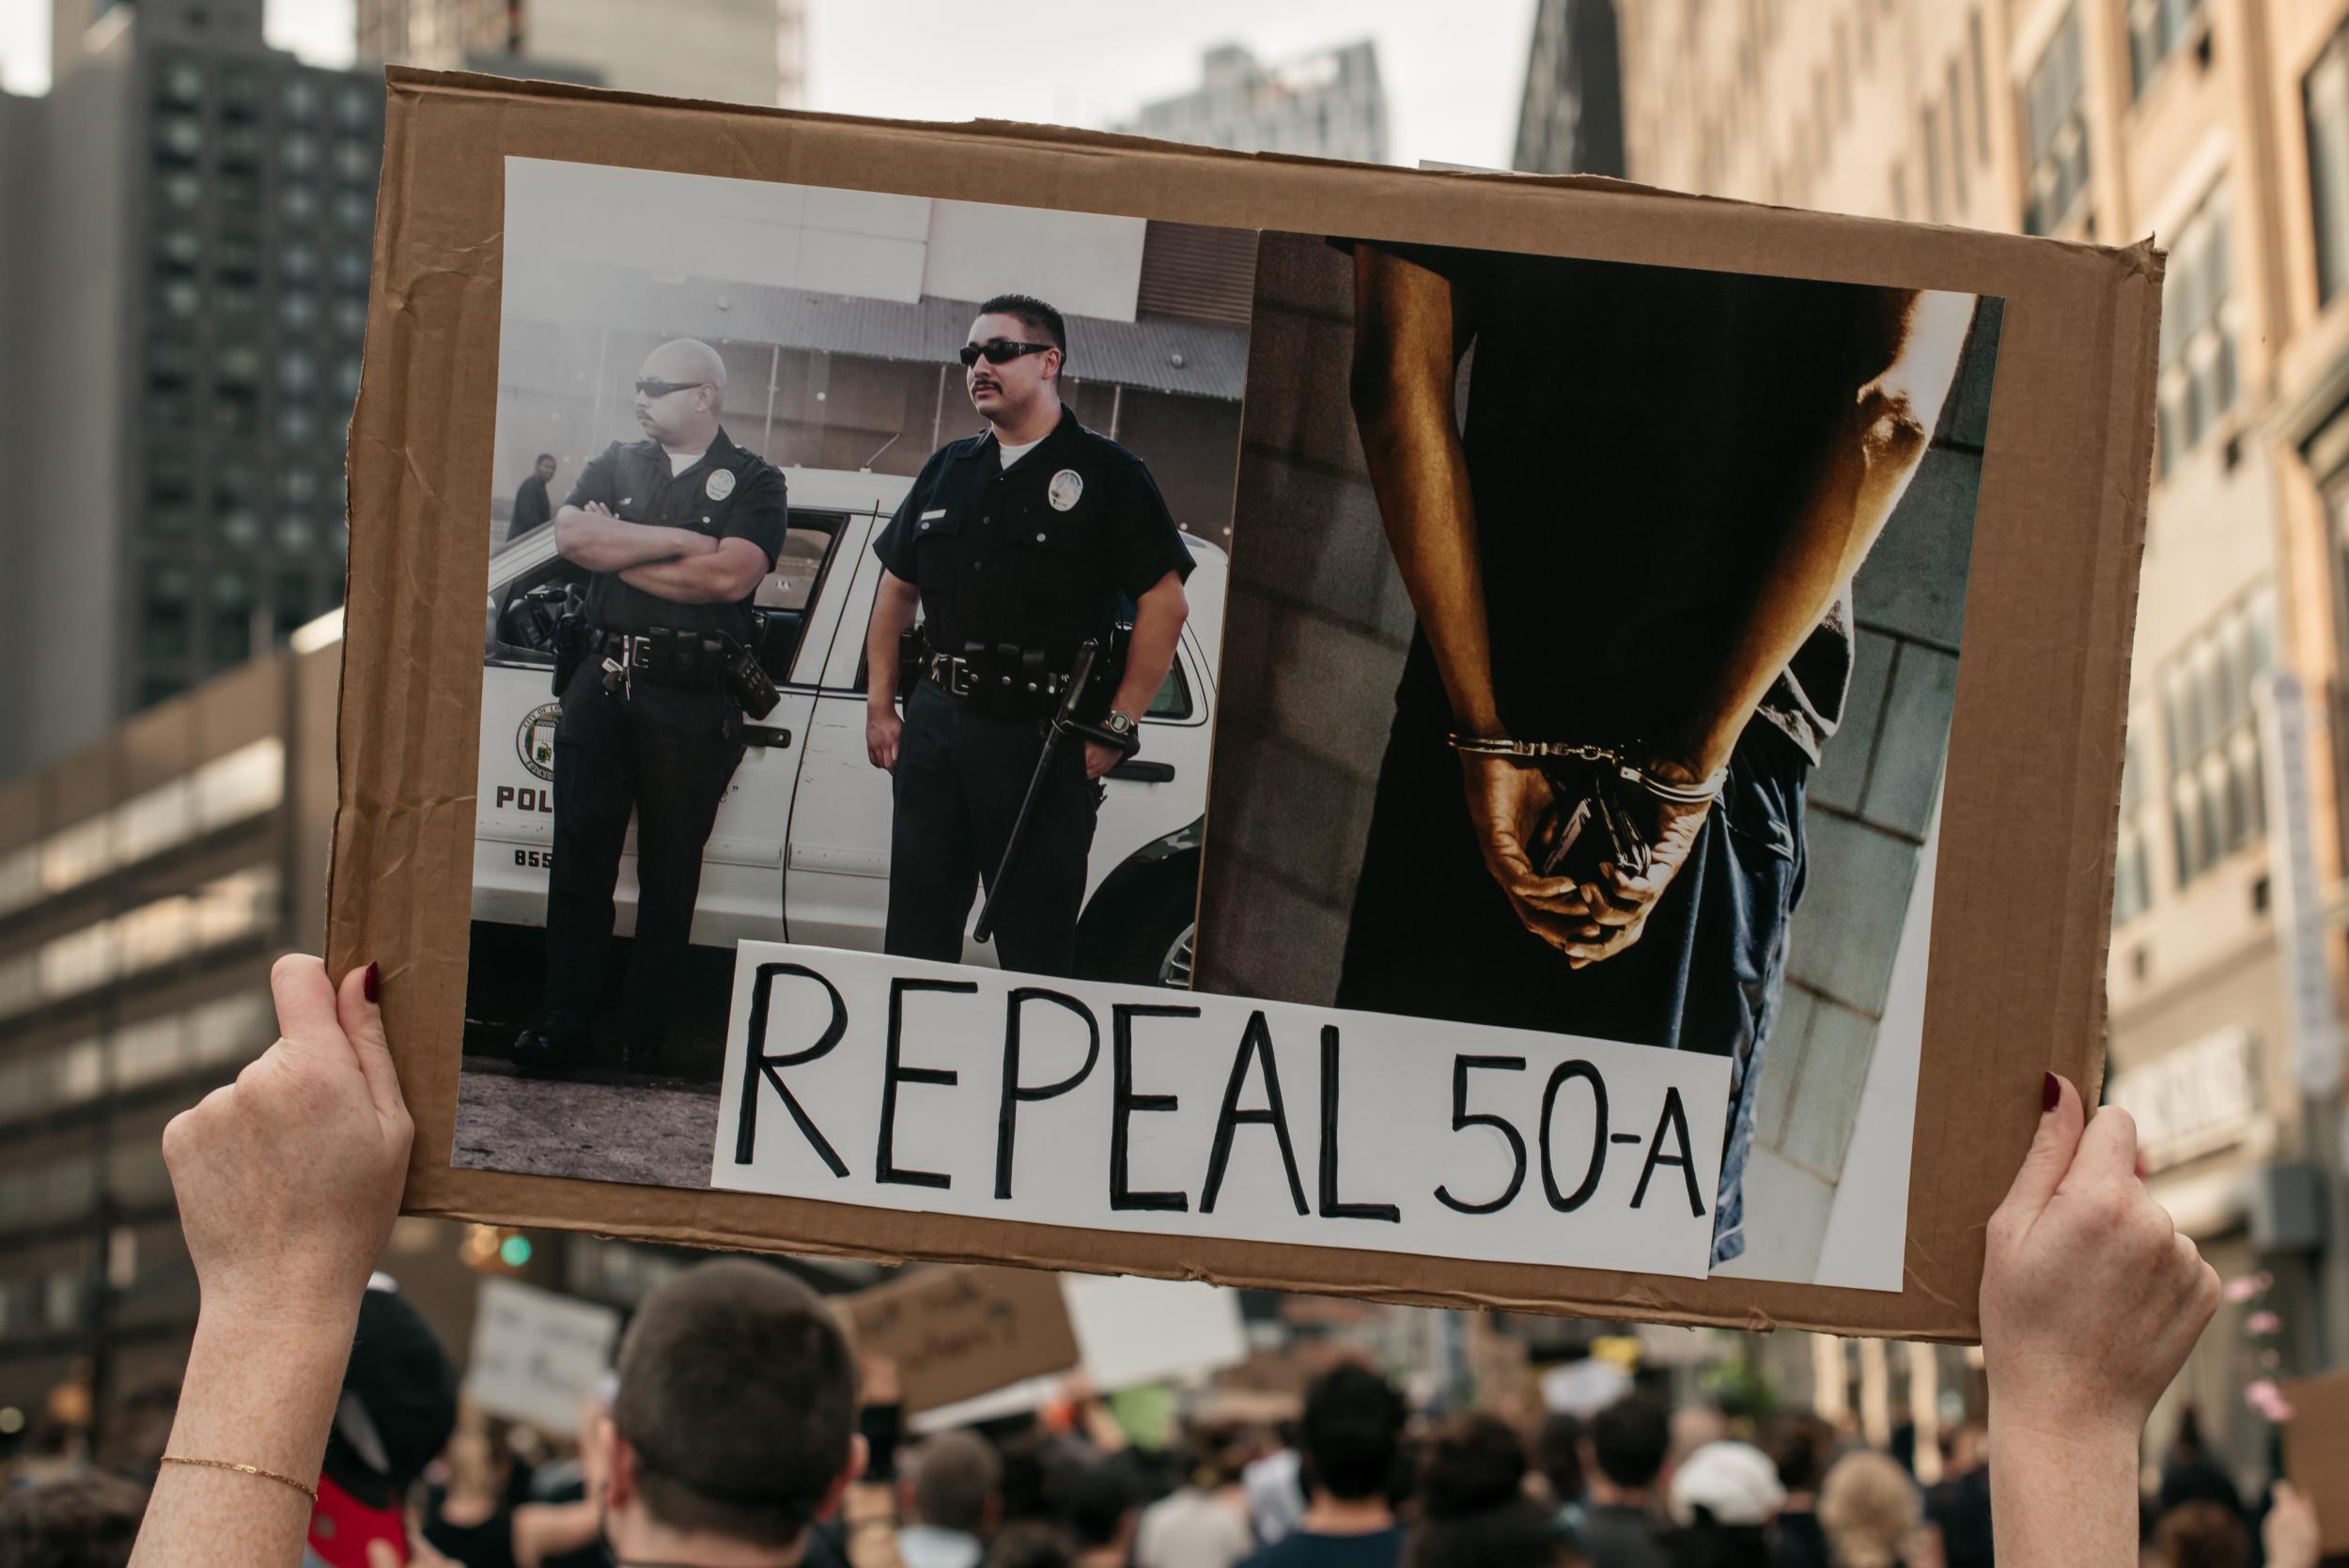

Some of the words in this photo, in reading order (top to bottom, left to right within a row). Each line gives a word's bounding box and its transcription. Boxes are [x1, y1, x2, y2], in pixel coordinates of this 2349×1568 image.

[496, 785, 552, 813] POL
[515, 849, 552, 868] 855
[735, 962, 1401, 1224] REPEAL
[1434, 1053, 1706, 1218] 50-A
